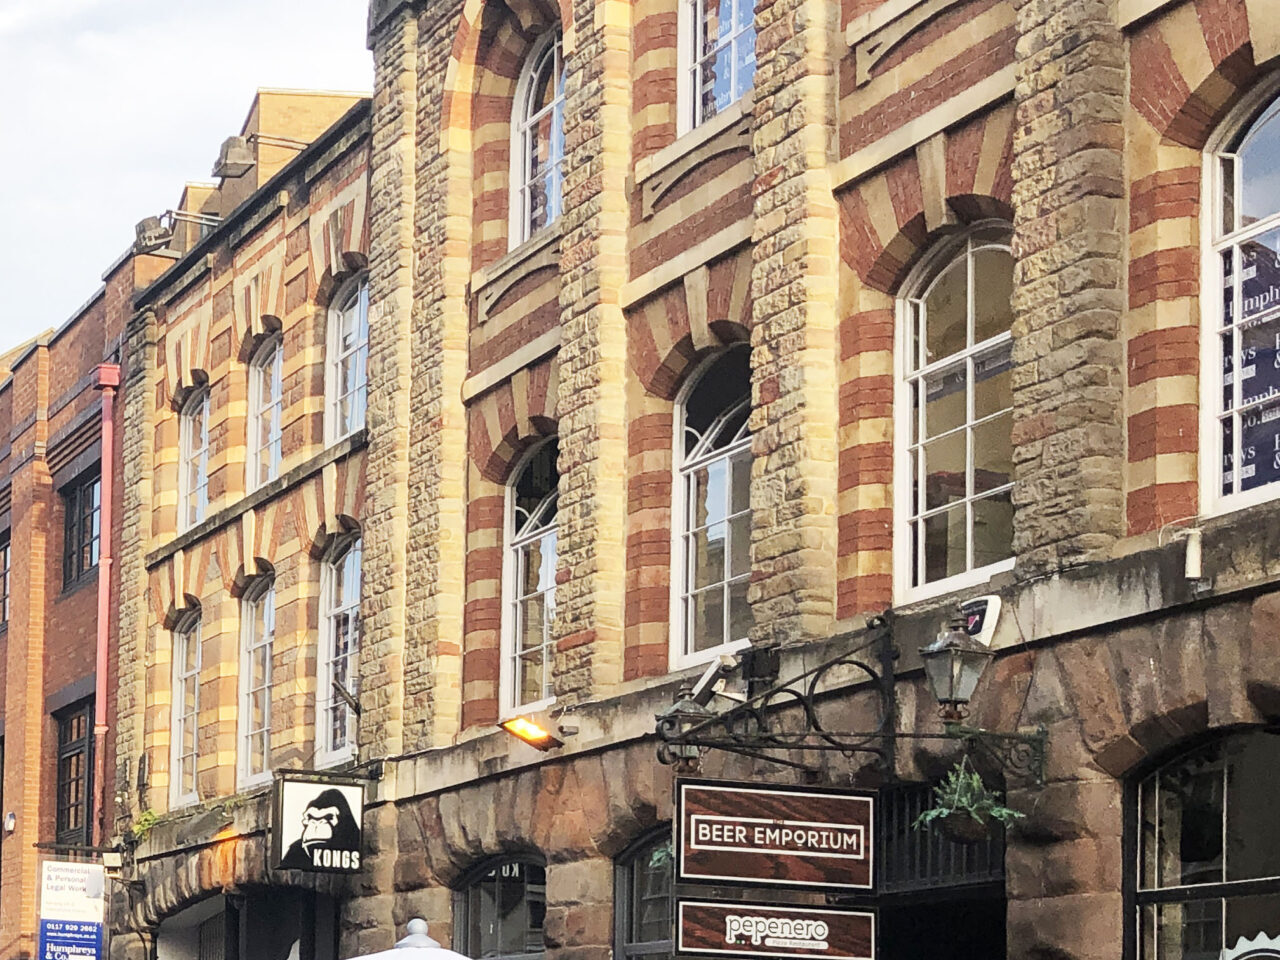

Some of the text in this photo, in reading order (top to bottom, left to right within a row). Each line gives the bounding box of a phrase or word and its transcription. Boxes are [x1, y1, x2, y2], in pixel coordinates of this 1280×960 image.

[698, 823, 857, 850] BEER EMPORIUM
[313, 848, 360, 869] KONGS
[47, 865, 90, 875] Commercial
[55, 875, 87, 884] Personal
[47, 883, 87, 893] Legal Work
[46, 922, 63, 931] 0117
[727, 916, 827, 944] pepenero
[46, 942, 97, 956] Humphreys
[45, 952, 68, 960] & Co.
